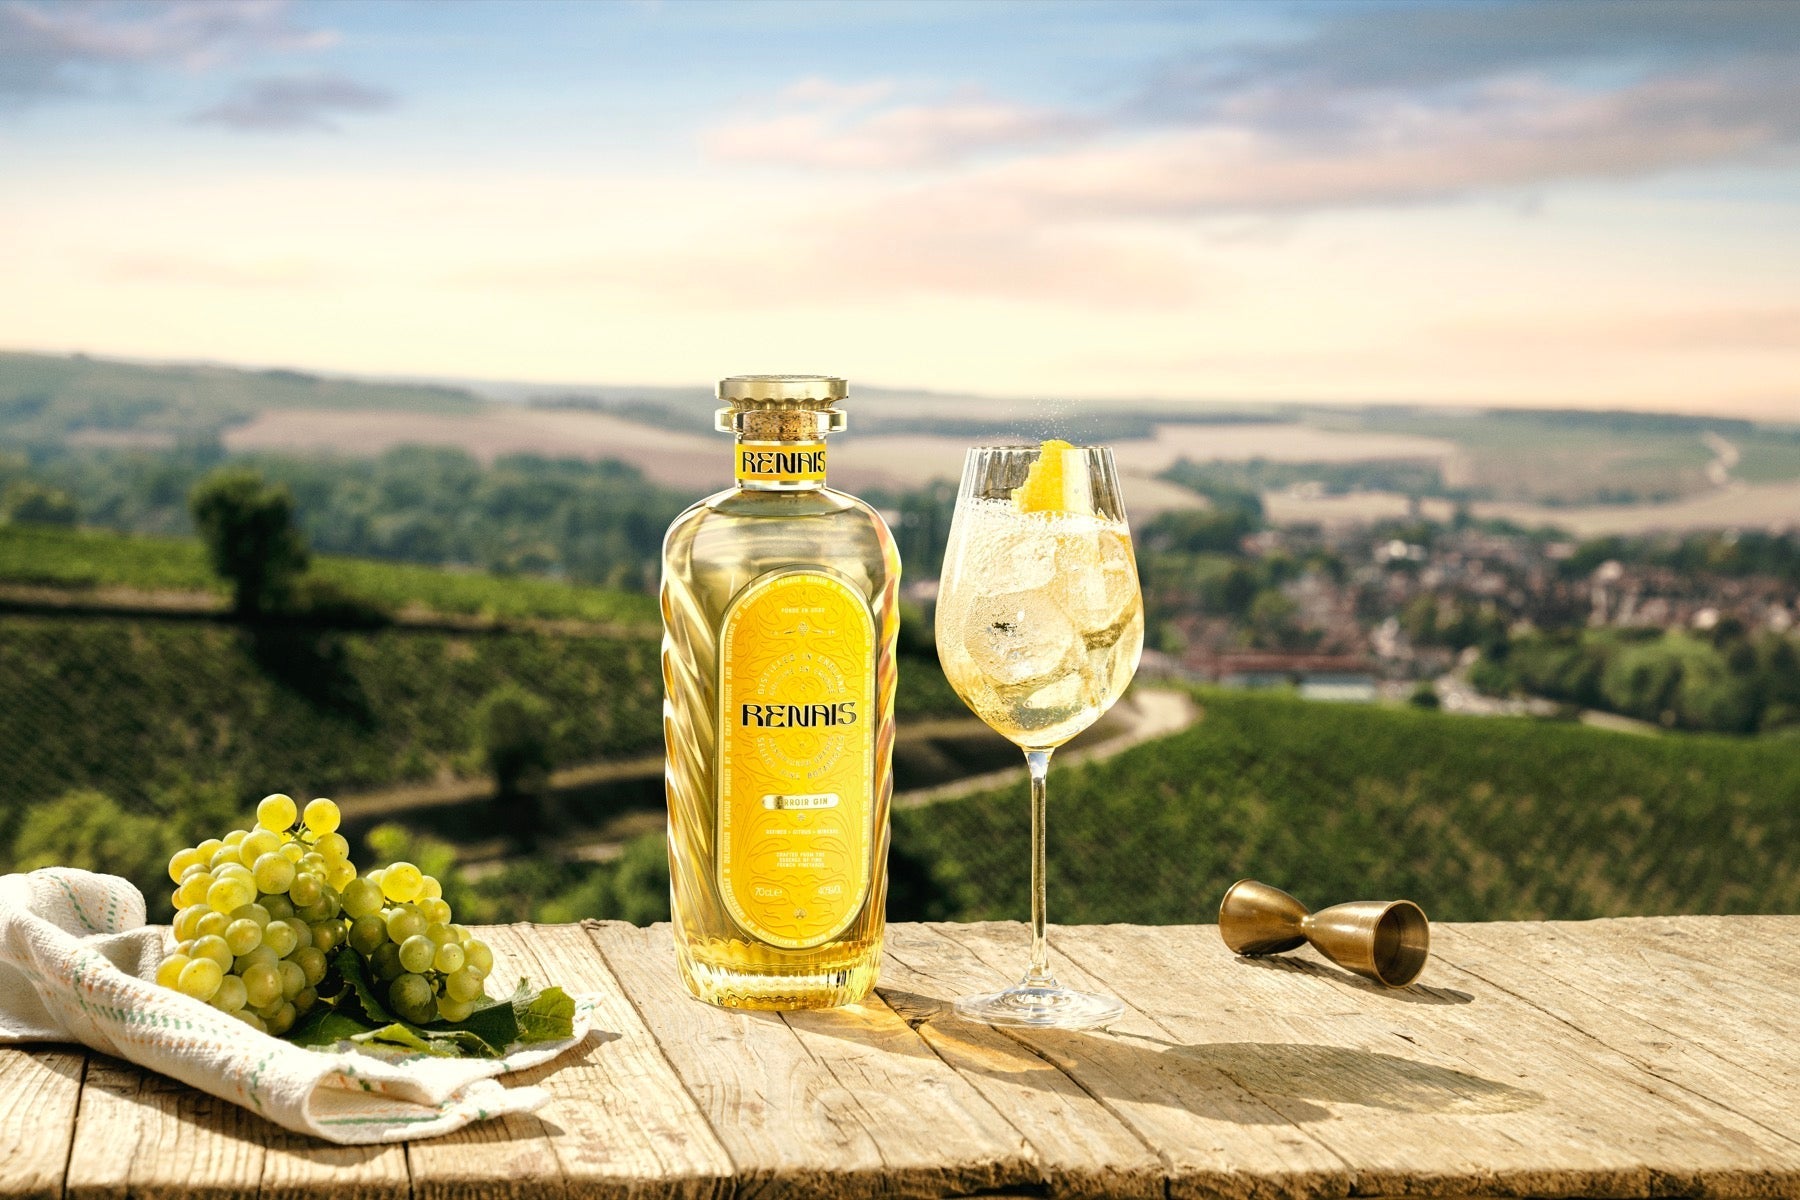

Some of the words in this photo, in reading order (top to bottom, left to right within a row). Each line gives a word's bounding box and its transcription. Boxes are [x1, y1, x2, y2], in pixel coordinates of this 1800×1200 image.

[742, 451, 826, 474] RENAIS
[757, 653, 796, 695] DISTILLED
[802, 652, 813, 661] IN
[816, 655, 846, 694] ENGLAND
[742, 702, 857, 728] RENAIS
[756, 736, 777, 769] SELECT
[776, 798, 809, 807] RROIR
[813, 797, 828, 806] GIN
